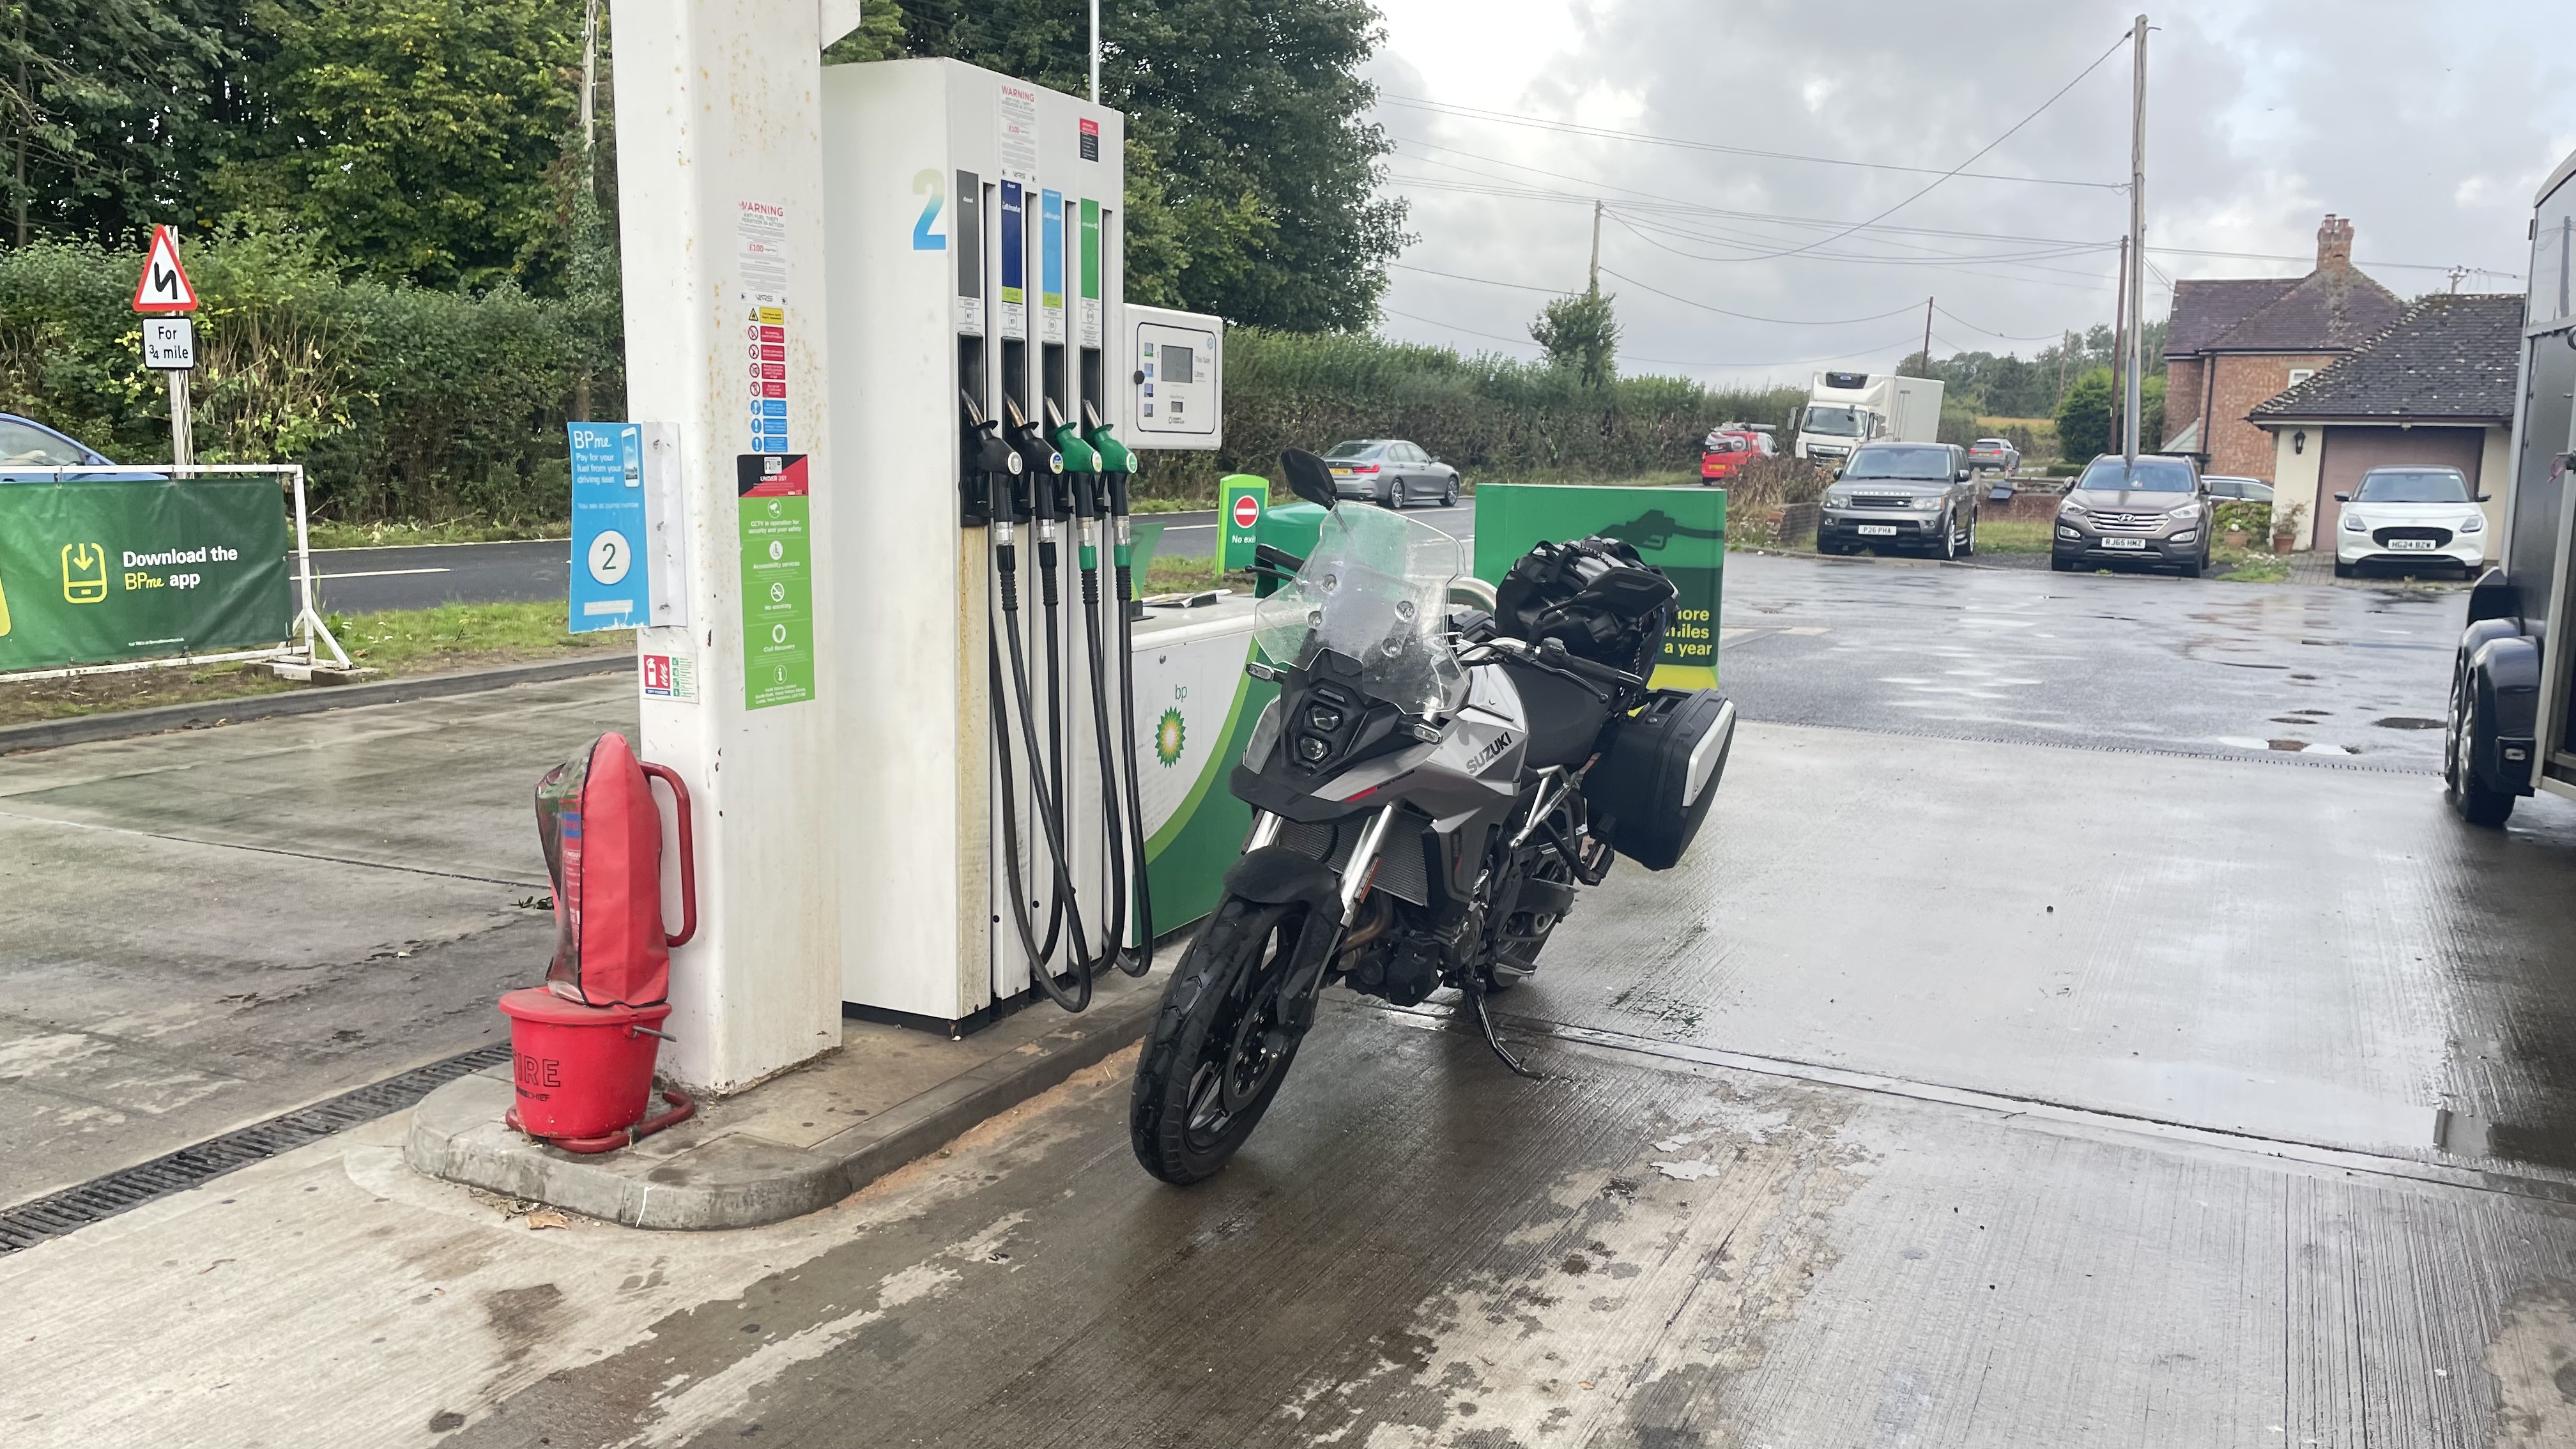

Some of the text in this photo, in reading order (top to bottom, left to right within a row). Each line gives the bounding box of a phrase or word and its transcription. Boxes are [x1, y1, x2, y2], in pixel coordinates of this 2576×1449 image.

[1002, 85, 1034, 102] WARNING
[739, 201, 783, 217] WARNING
[912, 167, 946, 250] 2
[749, 243, 763, 252] £100
[158, 326, 177, 340] For
[164, 345, 188, 359] mile
[574, 431, 611, 448] BPme
[576, 453, 588, 463] Pay
[577, 464, 589, 472] fuel
[591, 464, 606, 472] from
[578, 475, 600, 486] driving
[1232, 535, 1242, 543] No
[123, 546, 238, 567] Download the
[602, 543, 617, 570] 2
[125, 572, 201, 590] BPme app
[1678, 609, 1710, 621] ore
[1664, 643, 1712, 657] a year
[1175, 684, 1188, 703] bp
[1466, 731, 1512, 774] SUZUKI
